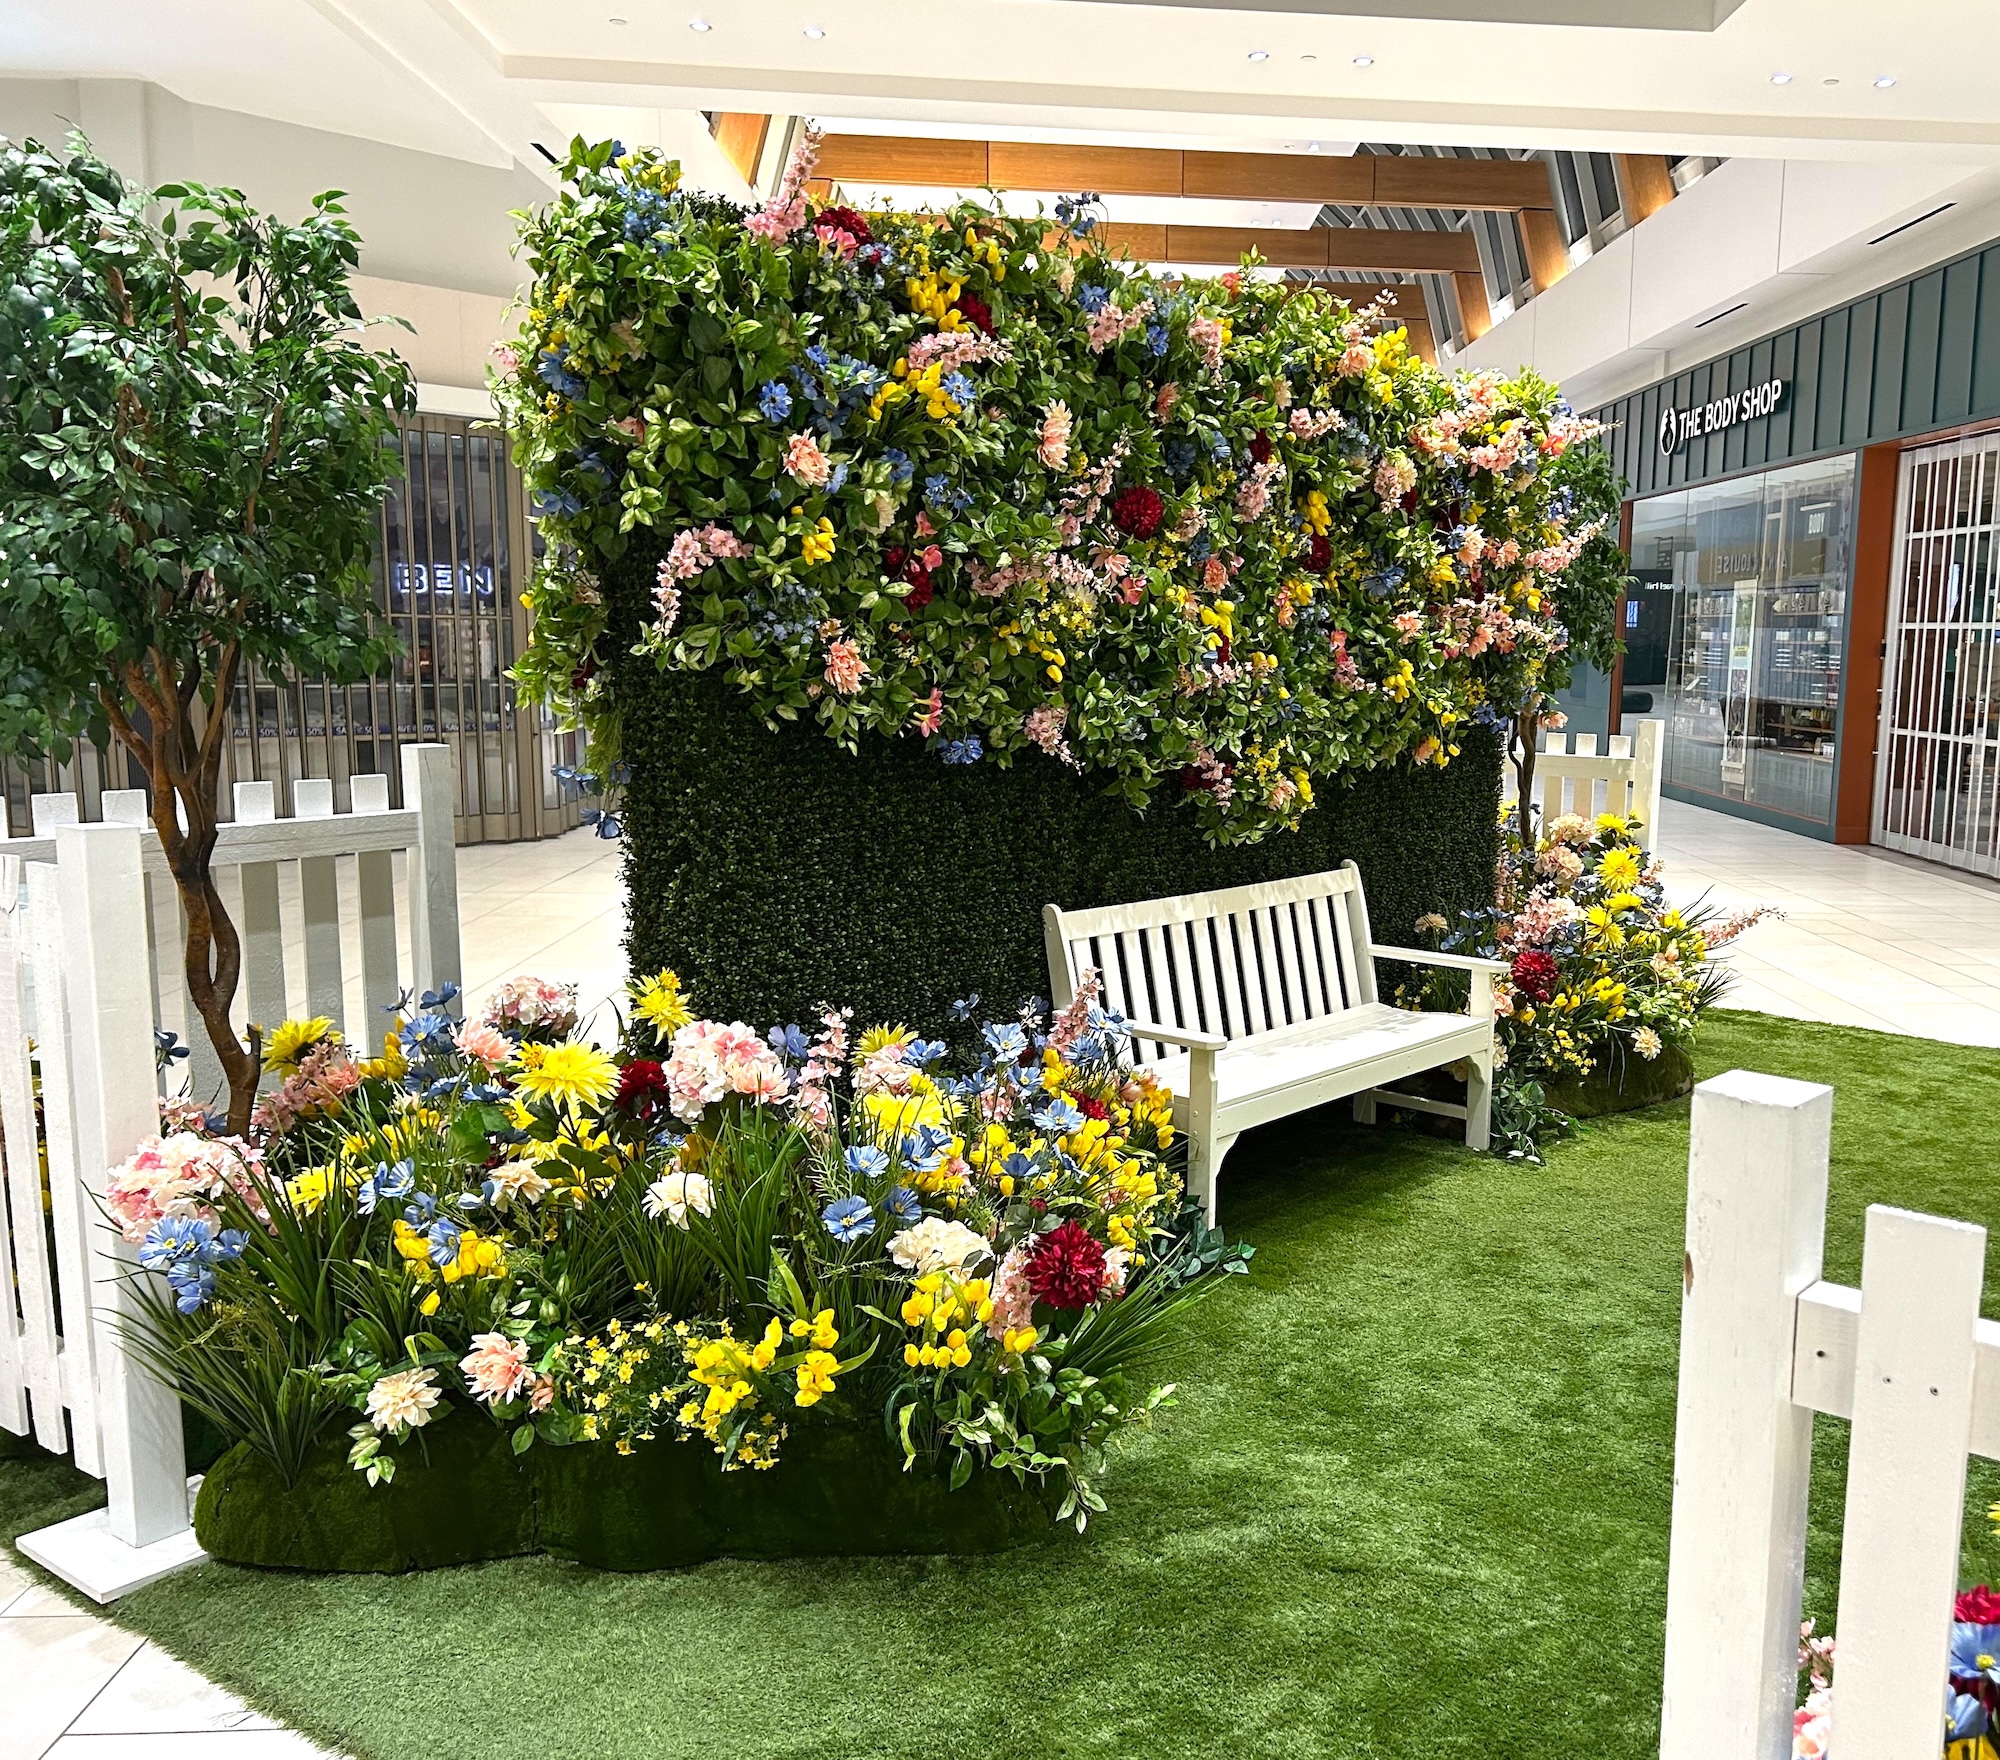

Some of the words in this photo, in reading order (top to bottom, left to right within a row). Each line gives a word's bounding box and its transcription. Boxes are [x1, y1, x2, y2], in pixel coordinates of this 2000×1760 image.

[1679, 406, 1703, 441] THE
[1704, 393, 1741, 434] BODY
[1740, 378, 1782, 421] SHOP
[397, 564, 493, 594] BEN
[232, 728, 250, 736] AVE
